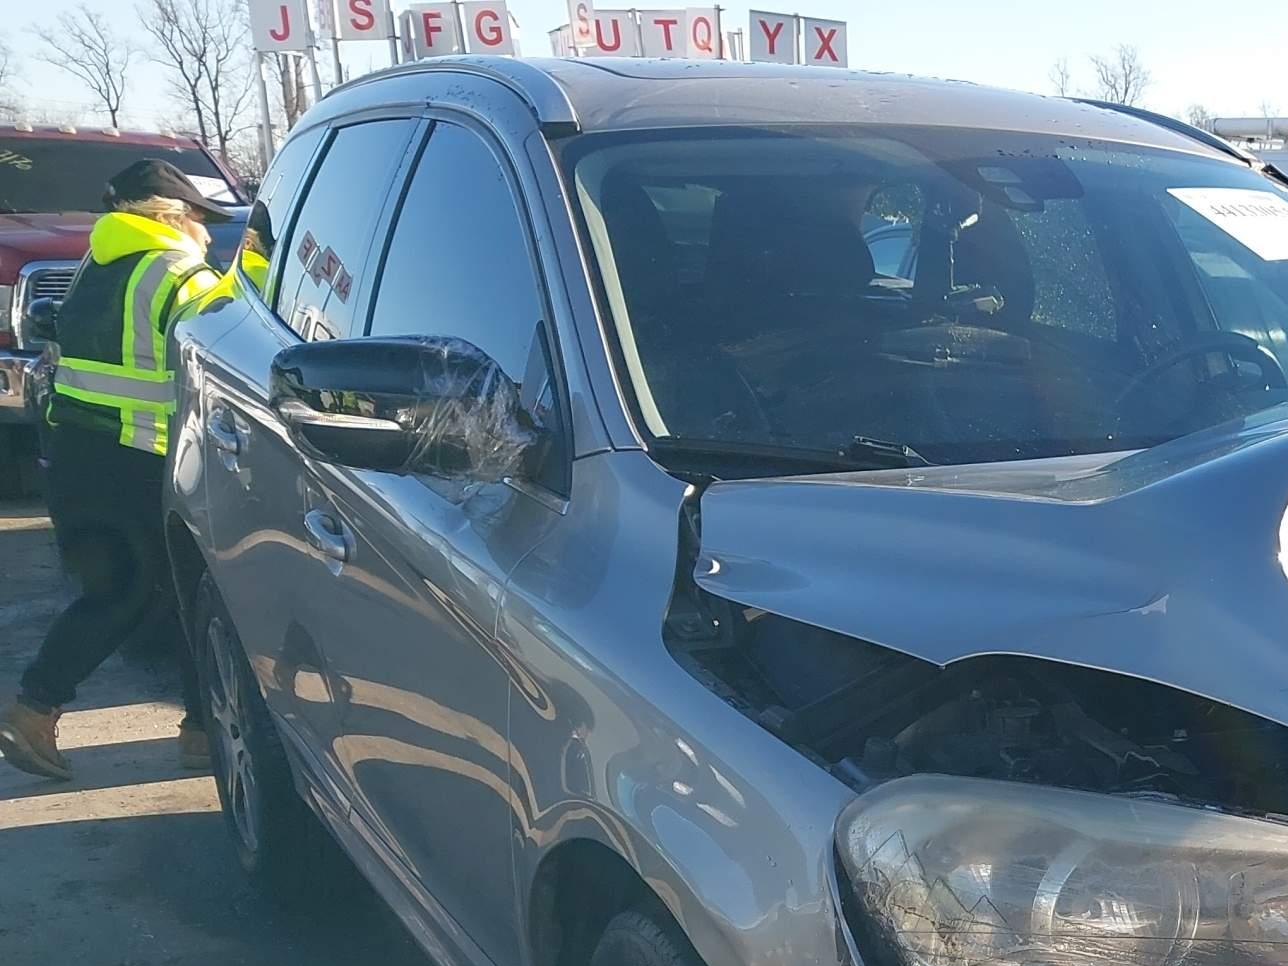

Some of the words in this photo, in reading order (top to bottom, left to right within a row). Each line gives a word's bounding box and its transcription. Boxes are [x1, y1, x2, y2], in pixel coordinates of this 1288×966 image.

[269, 5, 290, 42] J
[350, 0, 375, 31] S
[422, 12, 442, 47] F
[475, 10, 503, 46] G
[576, 3, 590, 36] S
[595, 19, 621, 51] U
[654, 19, 677, 51] T
[693, 16, 713, 53] Q
[758, 20, 784, 55] Y
[814, 27, 839, 62] X
